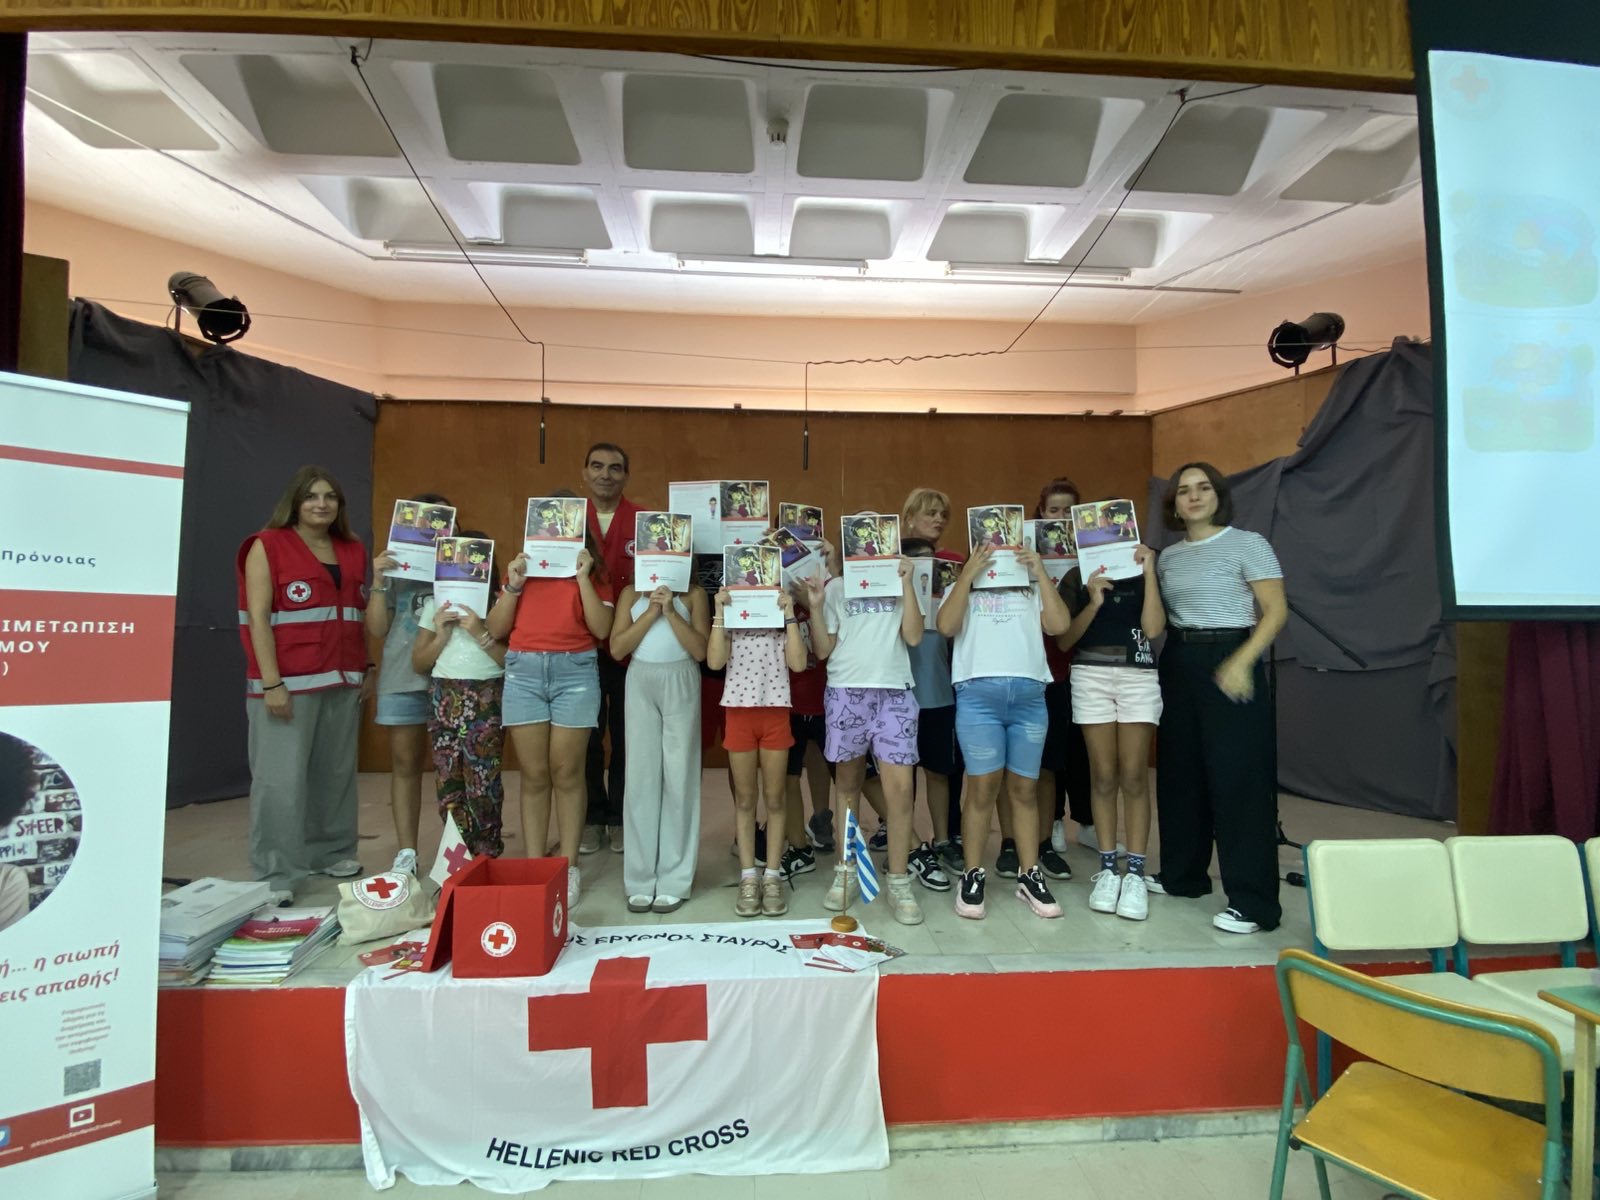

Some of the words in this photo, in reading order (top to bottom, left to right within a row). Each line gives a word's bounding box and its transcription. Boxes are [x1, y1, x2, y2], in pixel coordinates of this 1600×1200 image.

[2, 550, 96, 567] Πρόνοιας
[2, 619, 134, 634] ΙΜΕΤΩΠΙΣΗ
[0, 641, 50, 653] ΜΟΥ
[33, 957, 46, 972] η
[53, 940, 120, 966] σιωπή
[35, 968, 120, 997] απαθής!
[486, 1137, 604, 1169] HELLENIC
[612, 1144, 660, 1162] RED
[668, 1118, 749, 1156] CROSS
